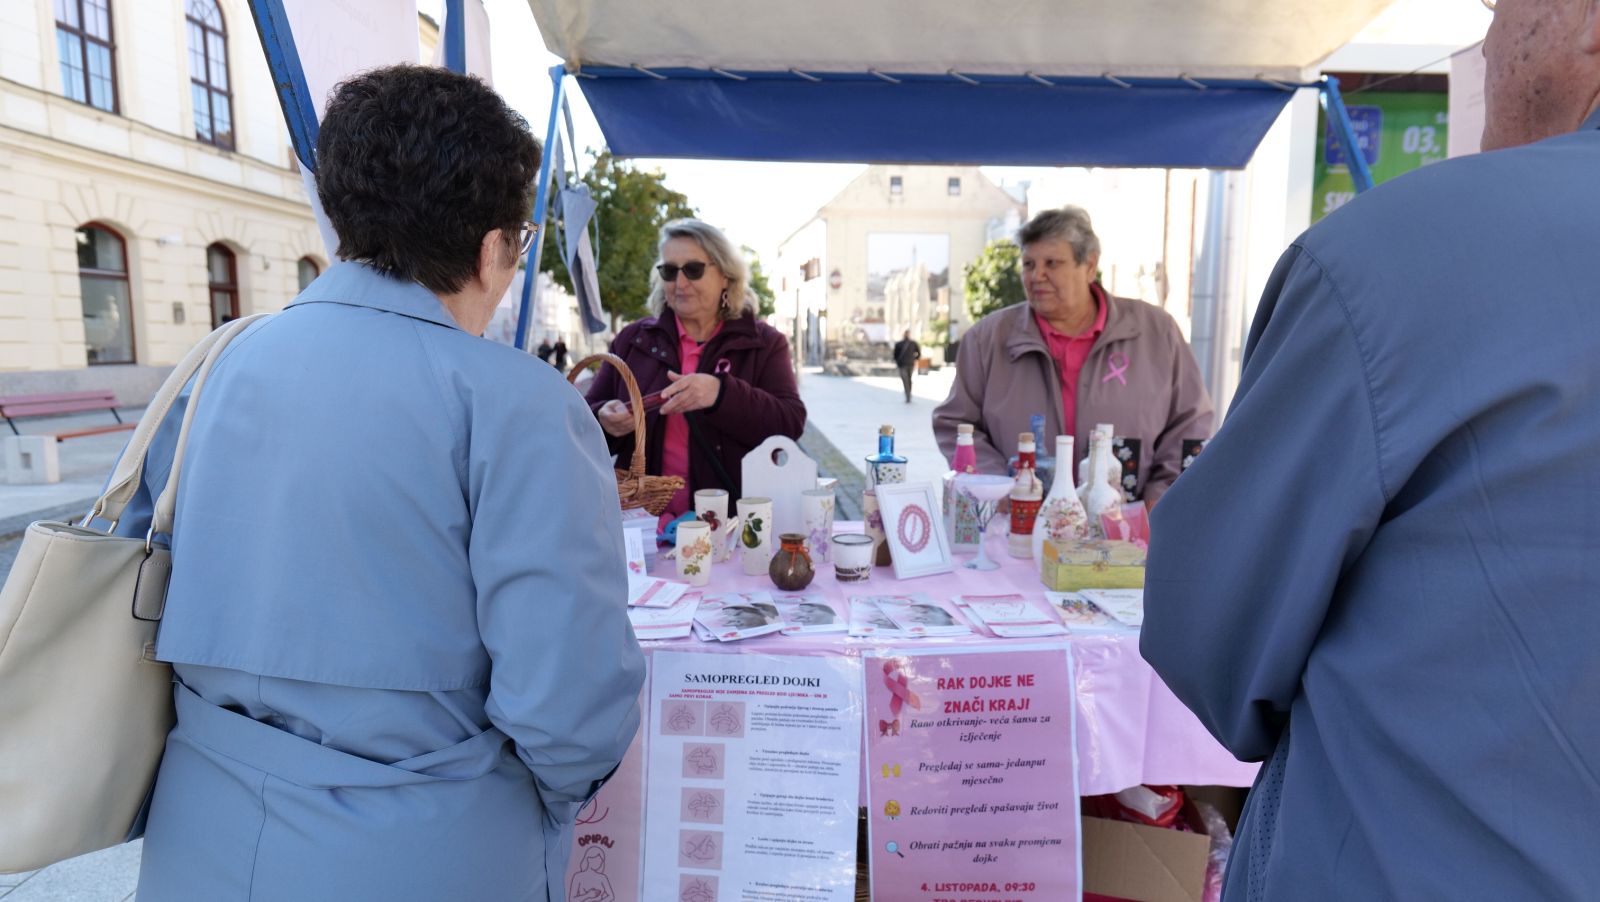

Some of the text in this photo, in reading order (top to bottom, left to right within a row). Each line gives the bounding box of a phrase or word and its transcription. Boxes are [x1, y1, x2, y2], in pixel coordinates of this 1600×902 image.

[684, 673, 821, 688] SAMOPREGLED DOJKI
[937, 674, 1035, 690] RAK DOJKE NE
[944, 696, 985, 713] ZNAČI
[910, 719, 935, 728] Rano
[989, 715, 1010, 725] veća
[1012, 714, 1038, 724] šansa
[1040, 715, 1051, 723] za
[959, 731, 1002, 742] izlječenje
[918, 761, 963, 772] Pregledaj
[964, 762, 975, 770] se
[1005, 758, 1046, 770] jedanput
[961, 775, 1004, 786] mjesečno
[910, 801, 1059, 816] Redoviti pregledi spašavaju život
[577, 833, 615, 849] OPIPAJ
[909, 841, 940, 850] Obrati
[941, 839, 973, 851] pažnju
[989, 839, 1016, 848] svaku
[1017, 837, 1062, 847] promjenu
[972, 853, 998, 864] dojke
[920, 882, 931, 892] 4.
[1004, 881, 1036, 891] 09:30
